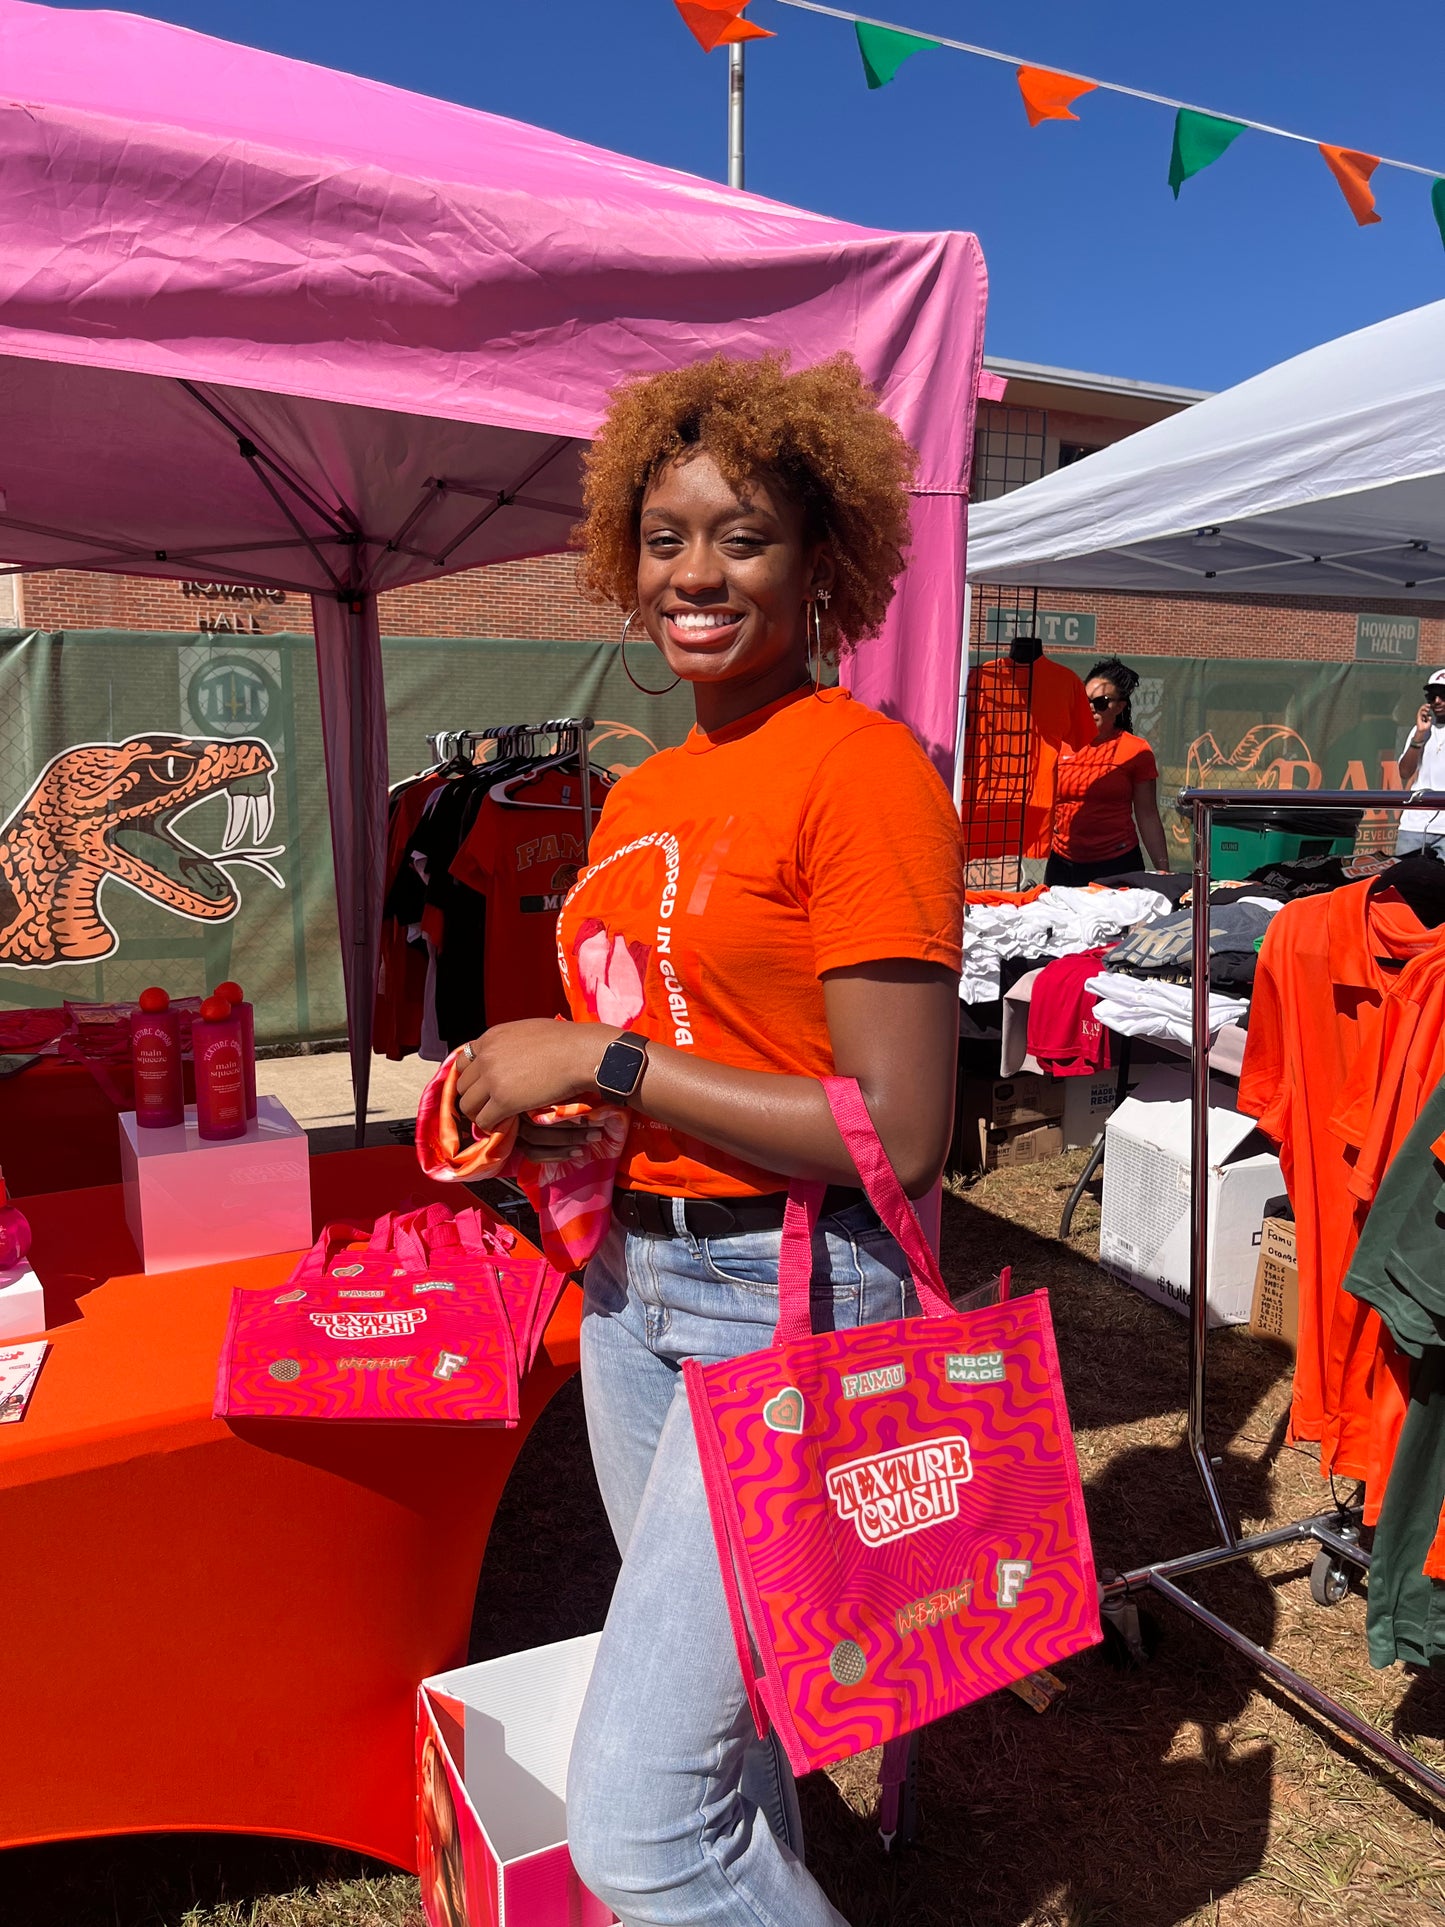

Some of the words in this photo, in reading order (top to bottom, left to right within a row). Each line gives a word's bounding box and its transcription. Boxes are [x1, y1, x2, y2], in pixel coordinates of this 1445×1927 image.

[197, 611, 261, 632] HALL
[1005, 613, 1080, 641] ROTC
[1360, 621, 1416, 640] HOWARD
[1371, 638, 1403, 654] HALL
[655, 831, 669, 846] &
[657, 926, 671, 954] IN
[140, 1049, 162, 1057] main
[215, 1061, 237, 1070] main
[315, 1310, 425, 1327] TEXTURE
[332, 1324, 409, 1337] CRUSH
[440, 1354, 463, 1377] F
[949, 1355, 1001, 1368] HBCU
[843, 1366, 904, 1397] FAMU
[949, 1368, 1003, 1380] MADE
[832, 1443, 965, 1511] TEXTURE
[861, 1479, 951, 1538] CRUSH
[1001, 1563, 1027, 1603] F
